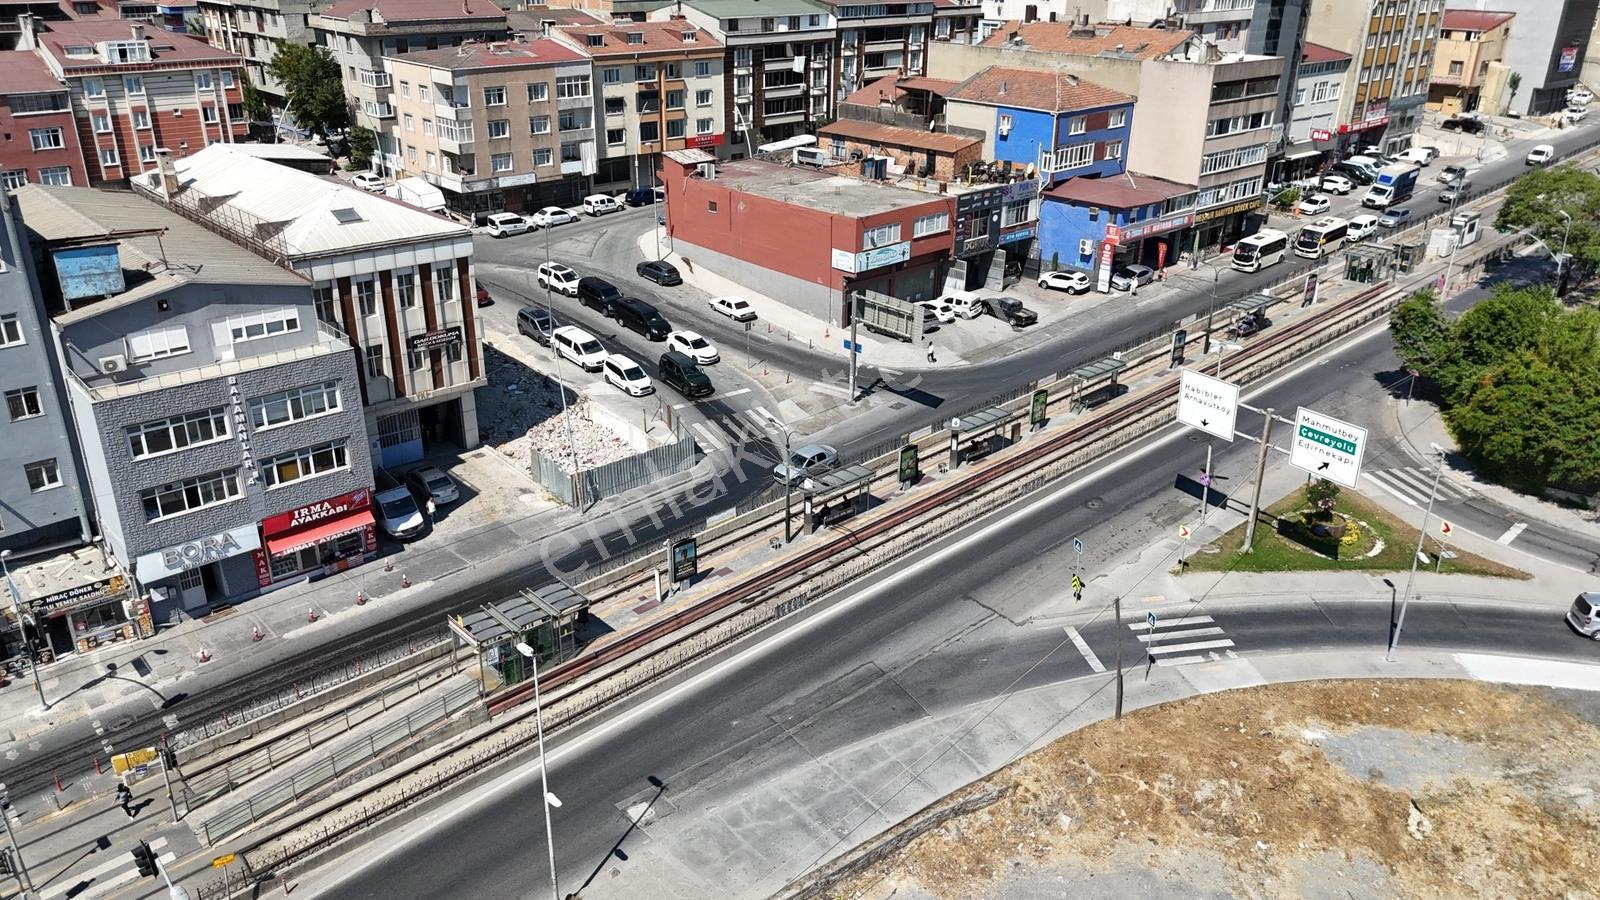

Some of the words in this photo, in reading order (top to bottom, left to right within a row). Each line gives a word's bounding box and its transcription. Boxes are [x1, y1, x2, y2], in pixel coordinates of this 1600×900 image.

[1185, 384, 1223, 401] Habibler
[228, 377, 254, 469] BALAMANLAR
[1302, 415, 1359, 442] Mahmutbey
[1301, 427, 1354, 454] Çevreyolu
[291, 504, 348, 527] AYAKKABI
[294, 502, 331, 519] IRMA
[161, 532, 240, 567] BORA
[283, 541, 316, 555] IRMAK
[320, 525, 366, 544] AYAKKABI
[46, 591, 68, 604] MİRAÇ
[69, 585, 93, 597] DÖNER
[54, 598, 78, 609] YEMEK
